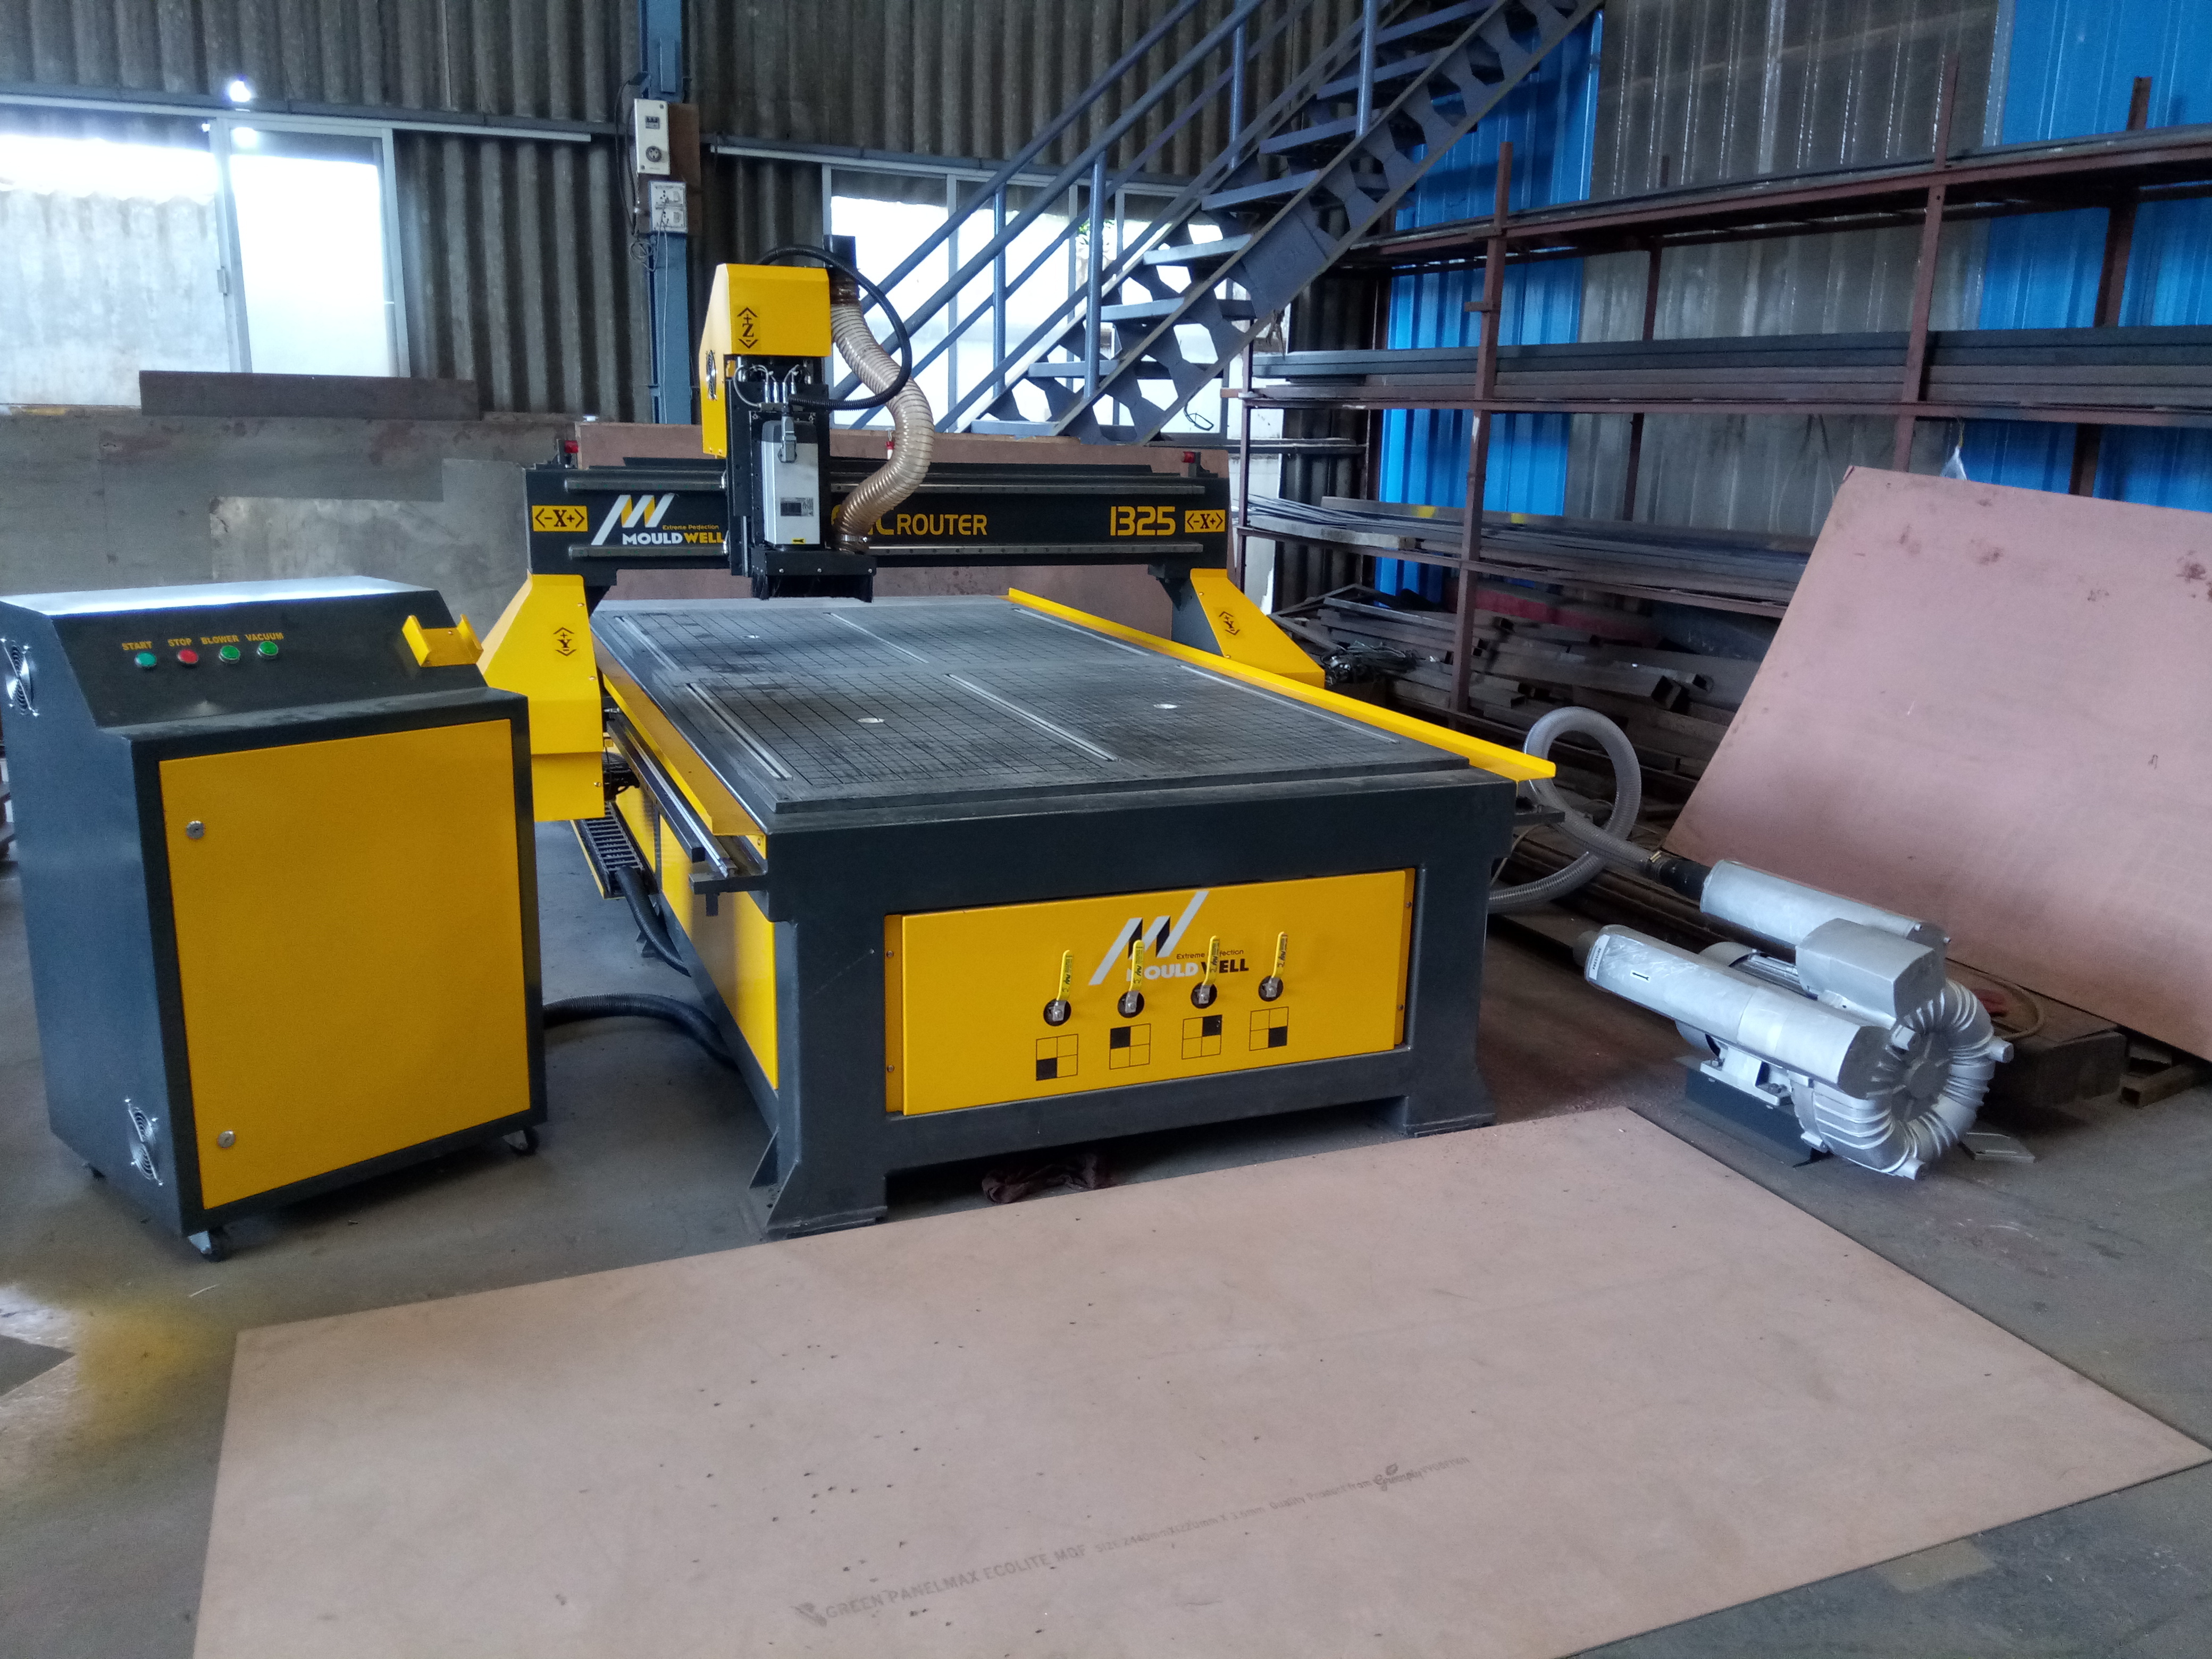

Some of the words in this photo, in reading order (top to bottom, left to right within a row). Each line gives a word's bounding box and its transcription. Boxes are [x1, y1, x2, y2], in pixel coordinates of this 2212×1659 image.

[897, 513, 987, 536] ROUTER
[1110, 505, 1176, 537] 1325
[200, 635, 239, 644] BLOWER
[245, 632, 284, 641] VACUUM
[122, 641, 152, 650] START
[167, 638, 192, 647] STOP
[1593, 948, 1602, 970] PRESSURE
[826, 1594, 884, 1618] GREEN
[888, 1571, 979, 1603] PANELMAX
[984, 1553, 1050, 1579] ECOLITE
[1054, 1544, 1086, 1562] MDF
